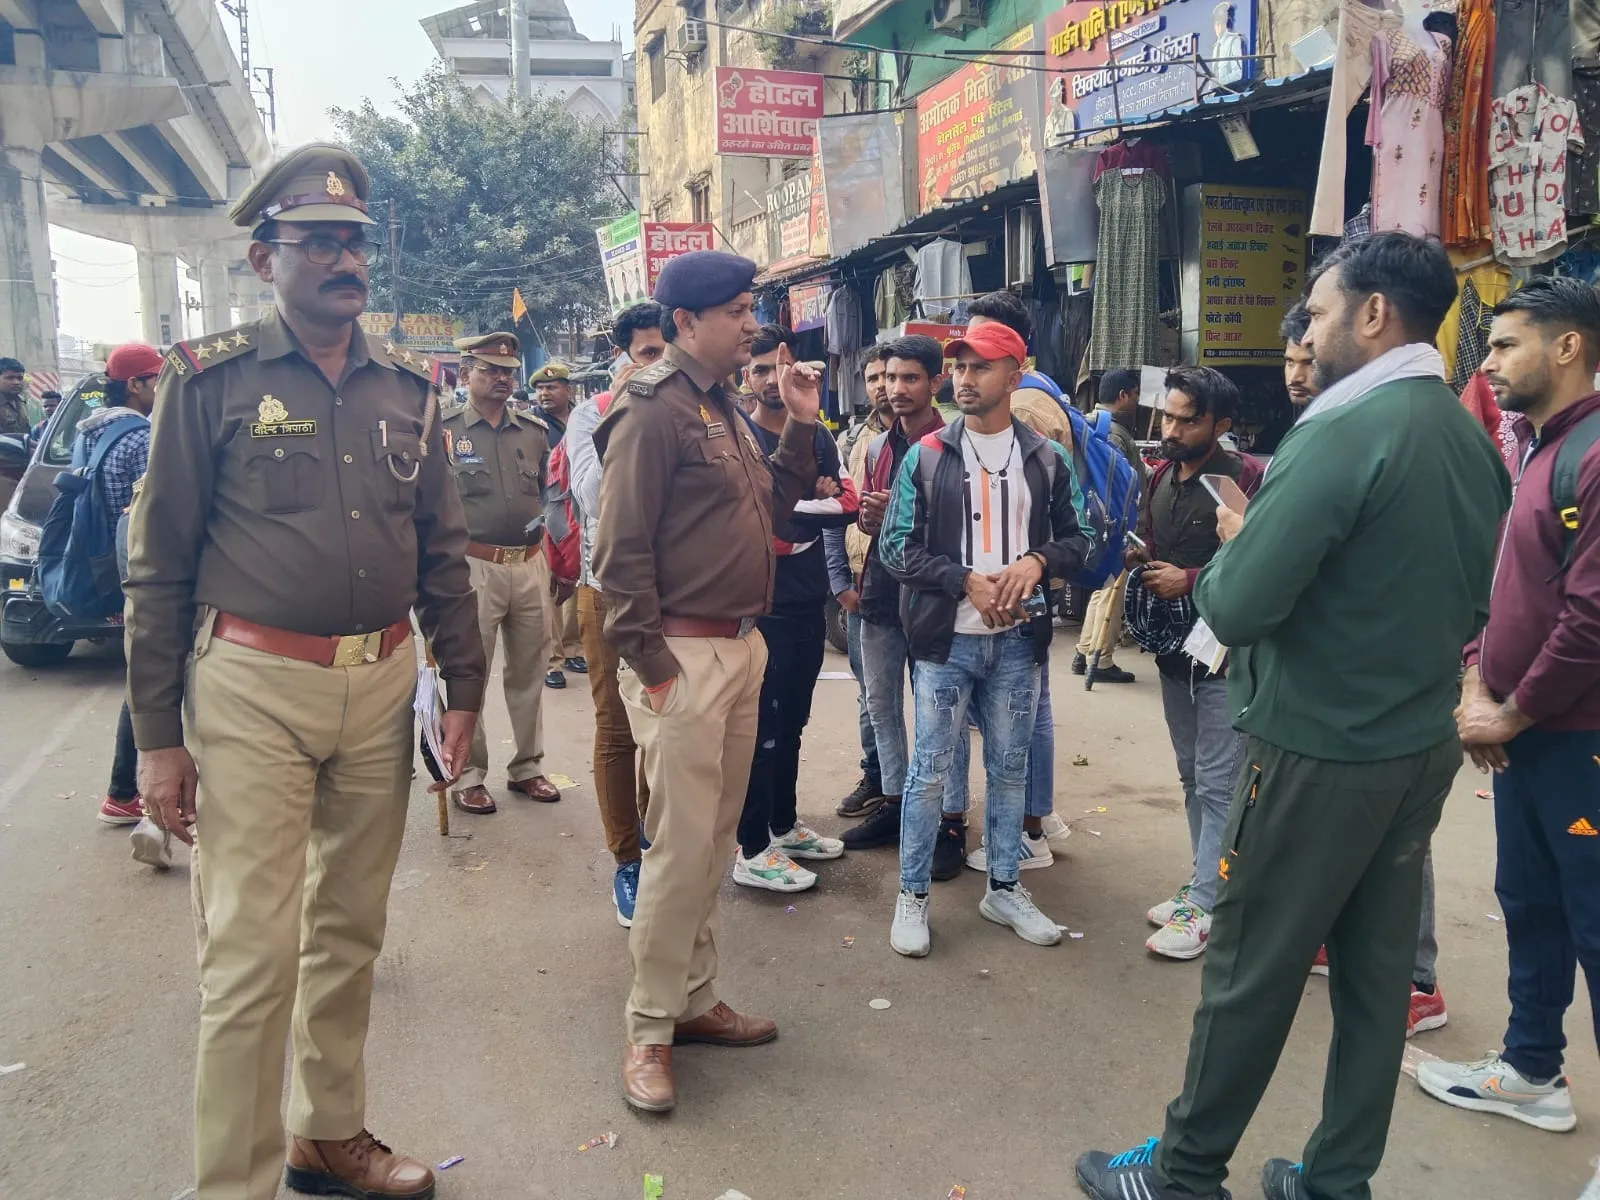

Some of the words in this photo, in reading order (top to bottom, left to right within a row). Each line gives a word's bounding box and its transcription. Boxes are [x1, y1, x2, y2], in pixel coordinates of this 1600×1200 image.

[745, 75, 817, 107] होटल
[648, 225, 710, 252] होटल
[362, 324, 453, 336] TUTRIALS
